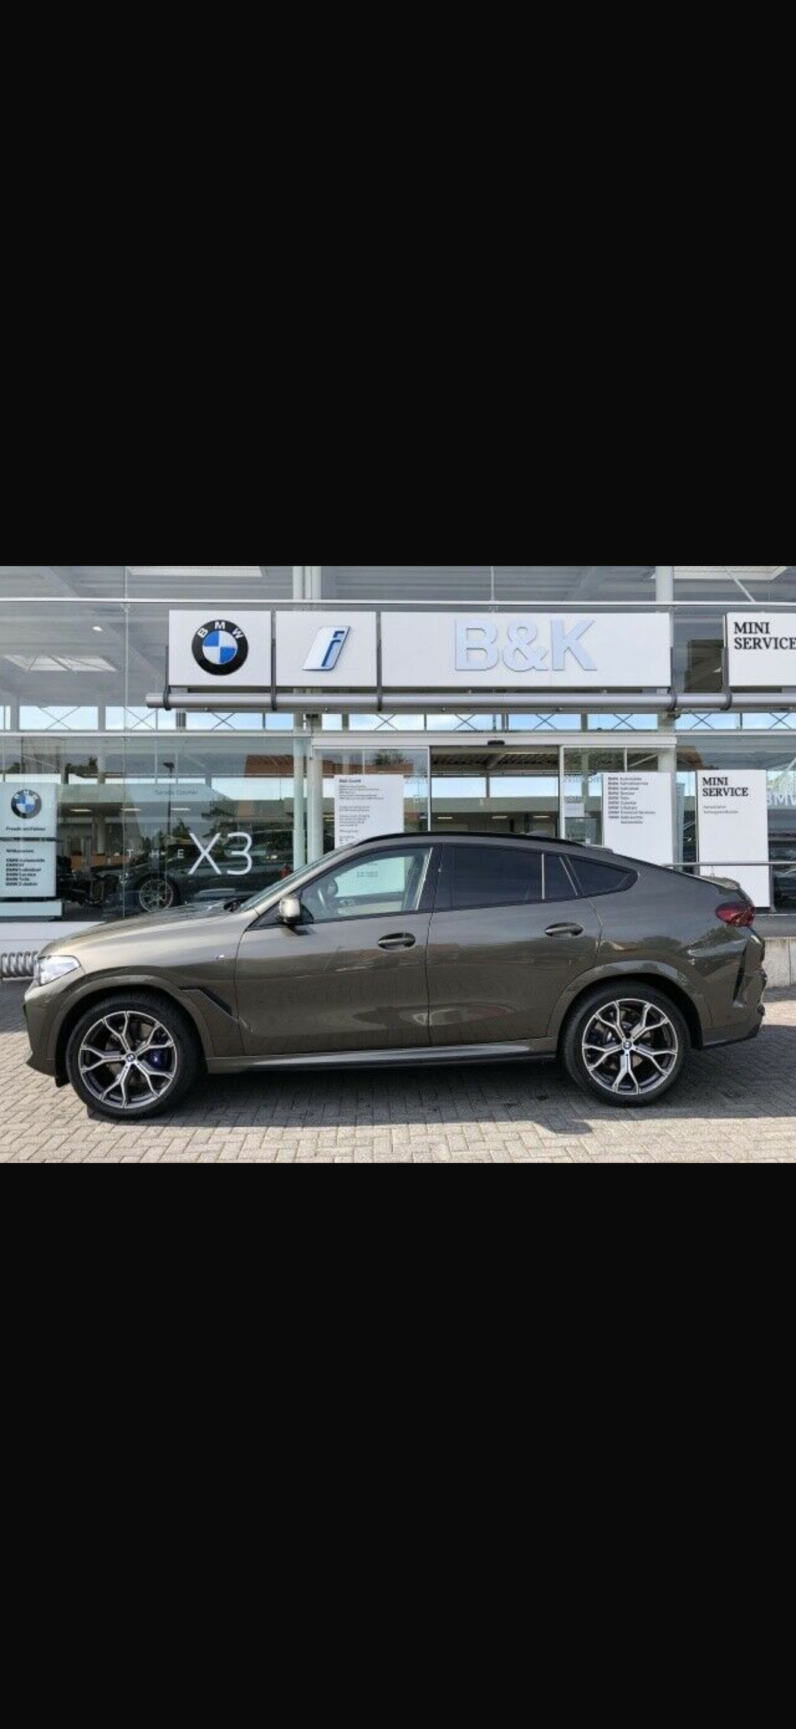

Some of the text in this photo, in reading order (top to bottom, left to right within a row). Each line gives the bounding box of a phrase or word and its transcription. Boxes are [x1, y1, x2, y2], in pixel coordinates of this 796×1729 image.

[197, 621, 244, 639] BMW
[734, 621, 770, 634] MINI
[454, 618, 598, 673] B&K
[734, 637, 796, 650] SERVICE
[702, 777, 728, 786] MINI
[702, 787, 749, 797] SERVICE
[187, 831, 253, 875] X3
